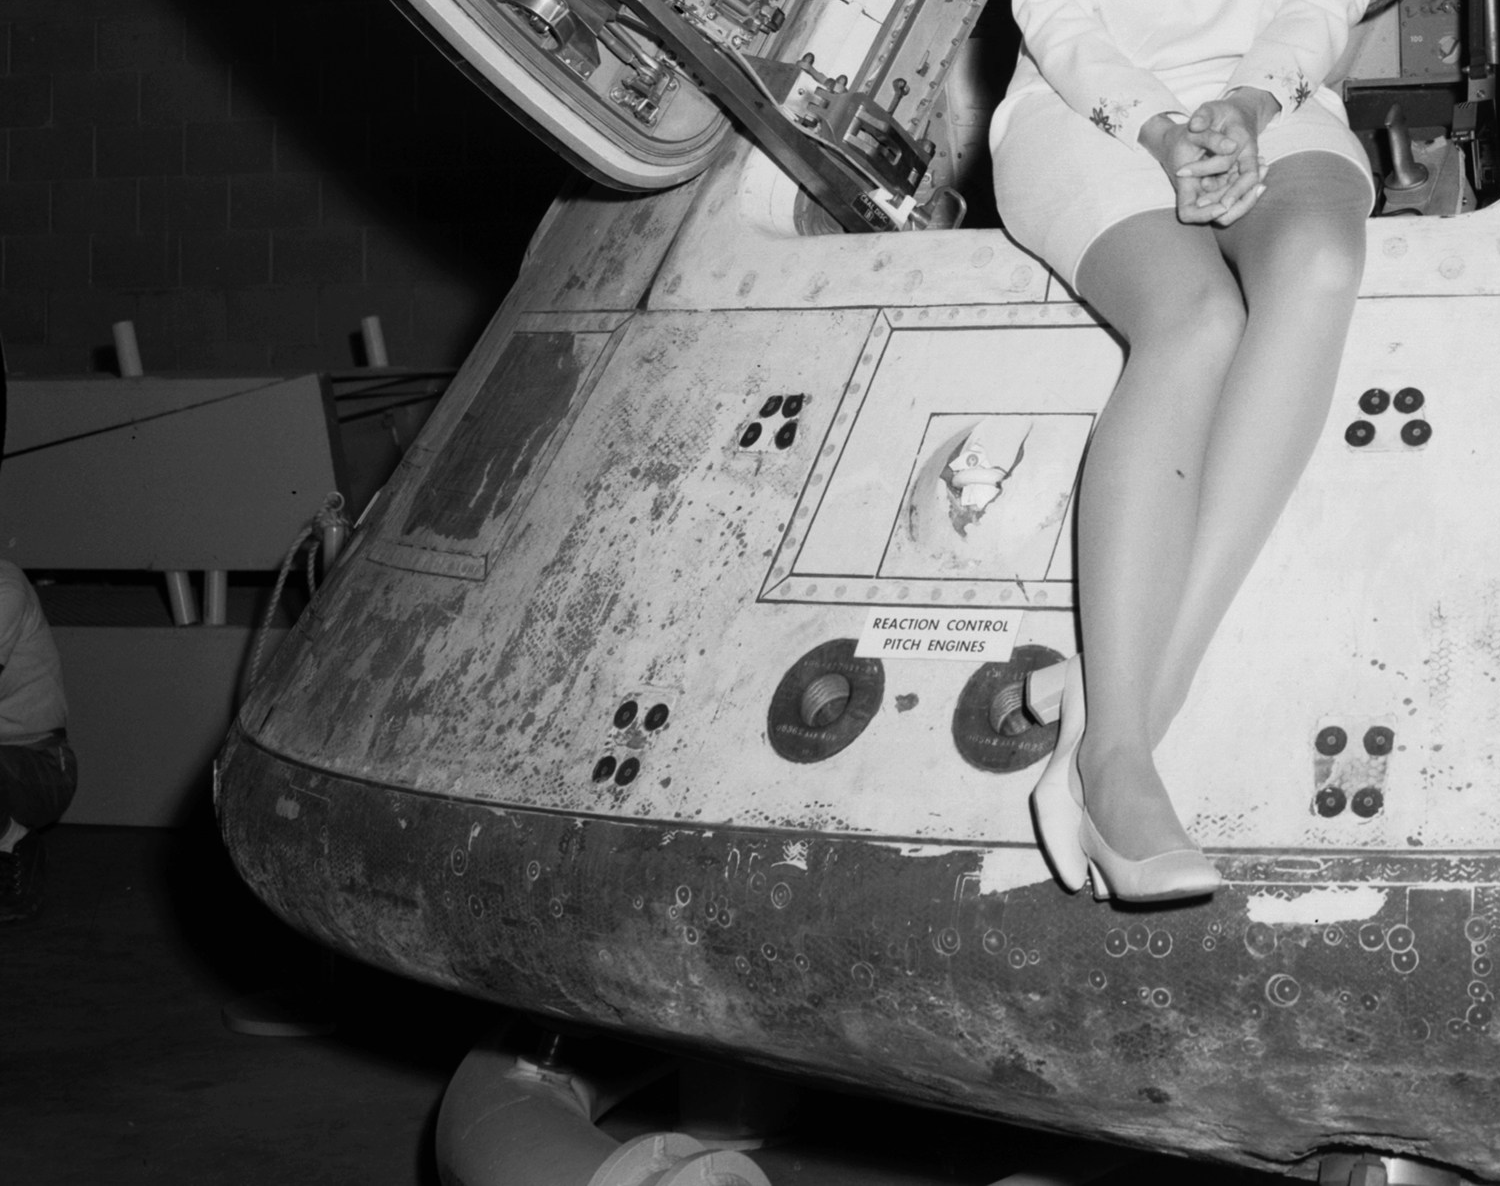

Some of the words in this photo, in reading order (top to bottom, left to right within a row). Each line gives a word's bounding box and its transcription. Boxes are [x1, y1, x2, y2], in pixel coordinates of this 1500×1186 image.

[872, 617, 940, 631] REACTION
[946, 619, 1009, 632] CONTROL
[882, 638, 921, 651] PITCH
[927, 639, 986, 652] ENGINES
